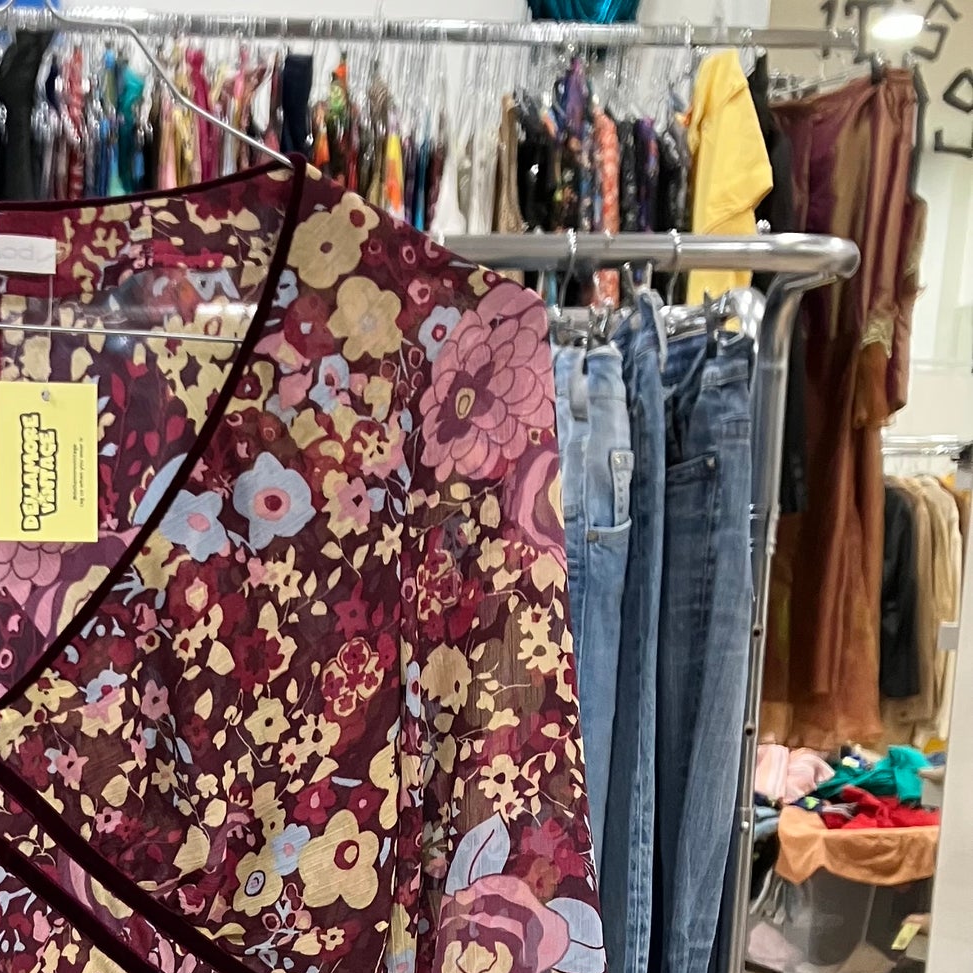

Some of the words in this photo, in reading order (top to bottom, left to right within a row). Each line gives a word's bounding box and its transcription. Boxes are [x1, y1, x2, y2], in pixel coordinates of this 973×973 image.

[820, 0, 962, 61] ITS
[20, 413, 40, 531] DELLAMORE
[39, 429, 57, 514] VINTAGE
